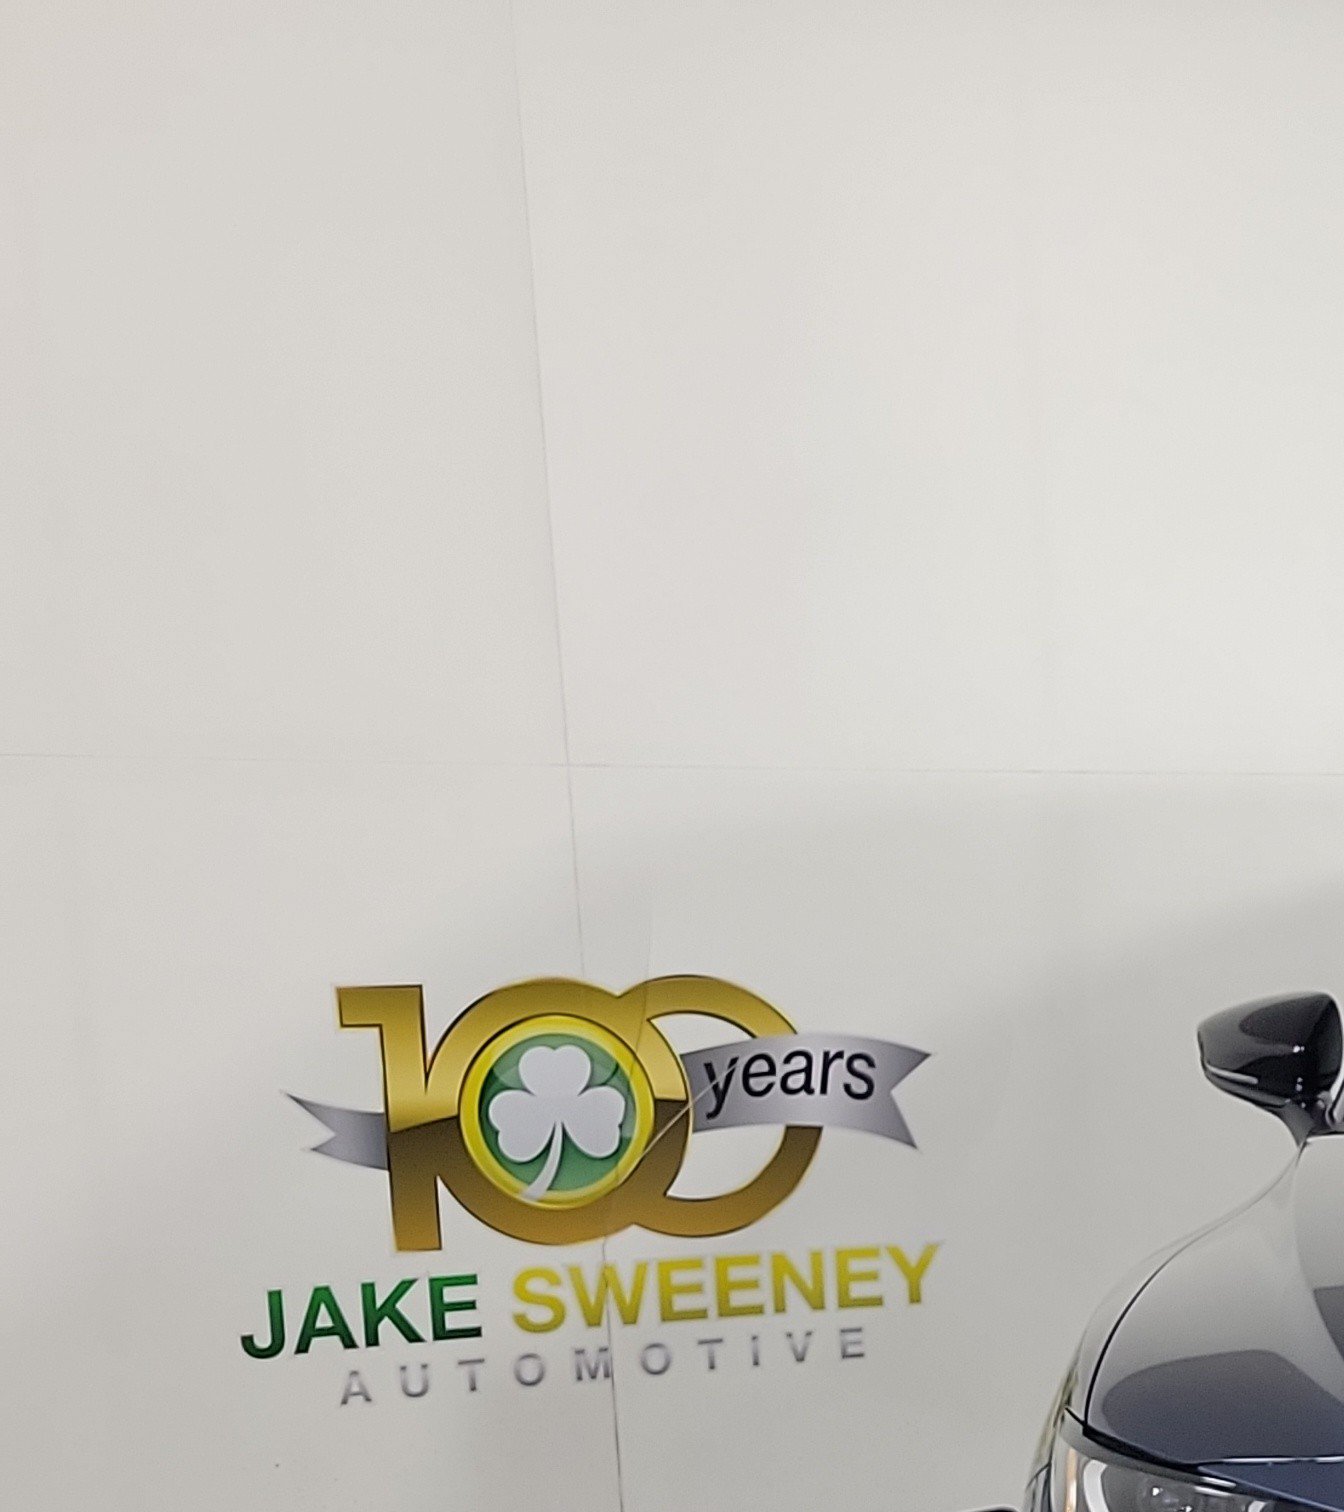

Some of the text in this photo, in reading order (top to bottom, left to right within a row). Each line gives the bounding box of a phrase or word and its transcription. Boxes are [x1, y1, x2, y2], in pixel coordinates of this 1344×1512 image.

[336, 974, 877, 1252] 100 years
[241, 1243, 941, 1359] JAKE SWEENEY
[340, 1328, 866, 1407] AUTOMOTIVE
